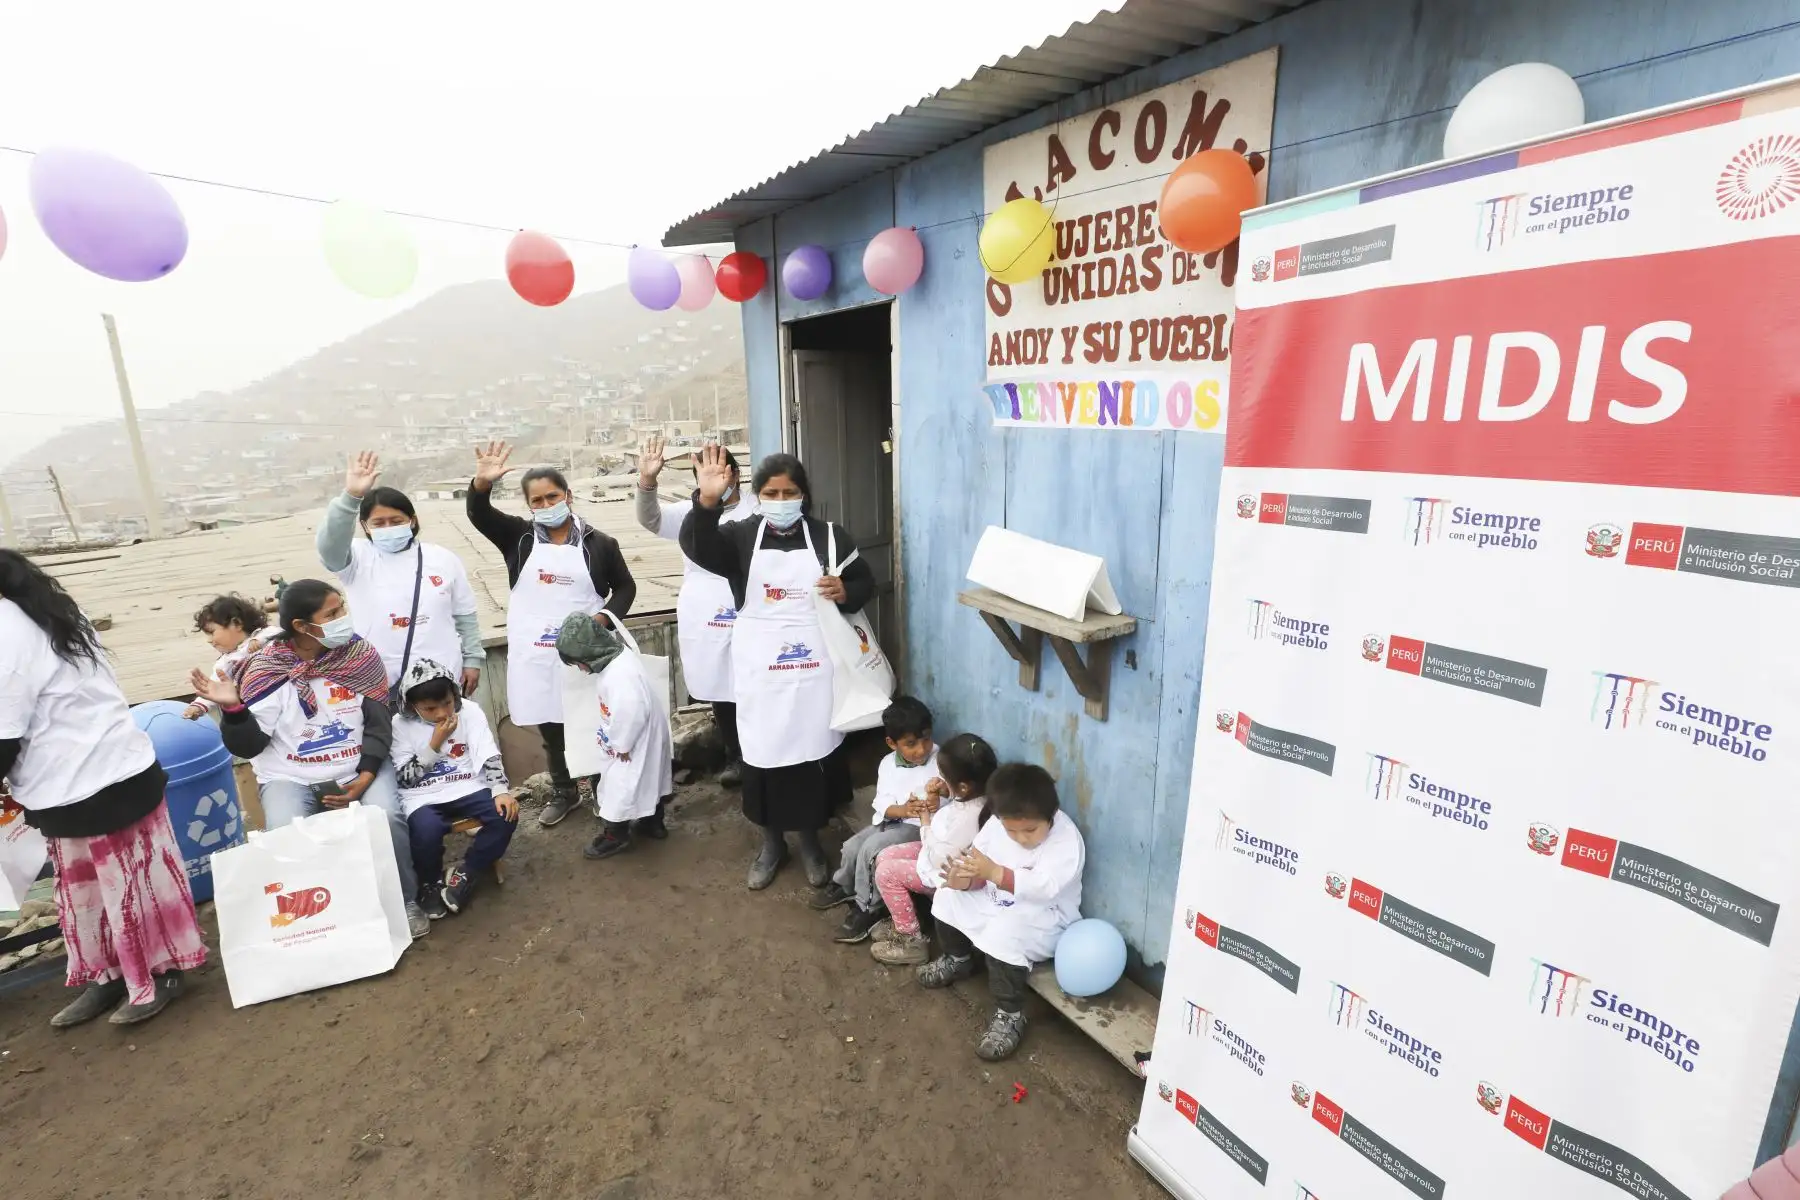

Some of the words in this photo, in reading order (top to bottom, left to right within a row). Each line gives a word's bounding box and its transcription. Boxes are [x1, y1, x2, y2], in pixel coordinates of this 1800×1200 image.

[1529, 184, 1633, 216] Siempre
[1526, 223, 1544, 233] con
[1548, 220, 1557, 229] el
[1559, 206, 1629, 234] pueblo
[1277, 258, 1296, 272] PERÚ
[1303, 251, 1339, 262] Ministerio
[1341, 248, 1350, 256] de
[1352, 240, 1386, 254] Desarrollo
[1308, 259, 1340, 269] Inclusión
[1343, 254, 1363, 264] Social
[1172, 250, 1200, 285] DE
[987, 328, 1053, 366] ANDY
[1060, 325, 1079, 365] Y
[1083, 320, 1123, 364] SU
[1340, 320, 1692, 425] MIDIS
[984, 380, 1220, 429] BIENVENIDOS
[1263, 503, 1283, 513] PERÚ
[1312, 507, 1319, 515] de
[1322, 509, 1362, 519] Desarrollo
[1312, 516, 1332, 524] Social
[1452, 507, 1541, 534] Siempre
[1449, 532, 1464, 540] con
[1468, 533, 1476, 542] el
[1479, 531, 1538, 550] pueblo
[1635, 539, 1674, 553] PERÚ
[1688, 544, 1745, 561] Ministerio
[1749, 552, 1767, 563] de
[1685, 557, 1692, 565] e
[1696, 557, 1745, 573] Inclusión
[1750, 565, 1793, 579] Social
[1273, 610, 1329, 636] Siempre
[1282, 633, 1327, 650] pueblo
[1392, 648, 1419, 662] PERÚ
[1427, 656, 1471, 673] Ministerio
[1474, 667, 1485, 677] de
[1488, 669, 1535, 689] Desarrollo
[1433, 666, 1472, 683] Inclusión
[1475, 677, 1502, 690] Social
[1660, 692, 1772, 741] Siempre
[1250, 731, 1279, 747] Ministerio
[1282, 742, 1291, 750] de
[1293, 745, 1328, 761] Desarrollo
[1252, 740, 1280, 754] Inclusión
[1283, 750, 1304, 760] Social
[1656, 718, 1678, 732] con
[1680, 726, 1691, 736] el
[1693, 726, 1766, 762] pueblo
[1408, 773, 1491, 815] Siempre
[1406, 793, 1421, 806] con
[1423, 799, 1431, 809] el
[1432, 801, 1488, 831] pueblo
[1235, 828, 1299, 863] Siempre
[1569, 843, 1608, 862] PERÚ
[1233, 847, 1245, 855] con
[1248, 850, 1254, 858] el
[1256, 851, 1297, 876] pueblo
[1354, 890, 1377, 907] PERÚ
[1618, 868, 1626, 876] e
[1630, 870, 1682, 898] Inclusión
[1685, 892, 1716, 915] Social
[1621, 856, 1680, 886] Ministerio
[1684, 880, 1698, 894] de
[1701, 882, 1762, 924] Desarrollo
[1198, 923, 1215, 938] PERÚ
[1385, 905, 1424, 930] Ministerio
[1427, 927, 1437, 936] de
[1440, 932, 1485, 959] Desarrollo
[1390, 917, 1425, 940] Inclusión
[1427, 935, 1453, 952] Social
[1221, 936, 1255, 954] Ministerio
[1265, 956, 1293, 980] Desarrollo
[1227, 945, 1255, 961] Inclusión
[1256, 958, 1272, 973] Social
[1367, 1009, 1442, 1064] Siempre
[1590, 989, 1700, 1056] Siempre
[1212, 1034, 1223, 1044] con
[1230, 1045, 1264, 1077] pueblo
[1214, 1019, 1266, 1065] Siempre
[1364, 1028, 1378, 1040] con
[1380, 1038, 1388, 1046] el
[1388, 1041, 1439, 1078] pueblo
[1587, 1013, 1609, 1026] con
[1613, 1021, 1624, 1032] el
[1625, 1024, 1694, 1073] pueblo
[1178, 1098, 1195, 1114] PERÚ
[1317, 1103, 1338, 1124] PERÚ
[1511, 1109, 1542, 1135] PERÚ
[1226, 1139, 1232, 1147] de
[1345, 1123, 1381, 1154] Ministerio
[1383, 1149, 1392, 1162] de
[1395, 1160, 1436, 1193] Desarrollo
[1350, 1134, 1381, 1163] Inclusión
[1383, 1160, 1406, 1180] Social
[1554, 1134, 1612, 1166] Ministerio
[1616, 1162, 1630, 1176] de
[1552, 1144, 1558, 1152] e
[1562, 1147, 1613, 1177] Inclusión
[1616, 1171, 1649, 1199] Social
